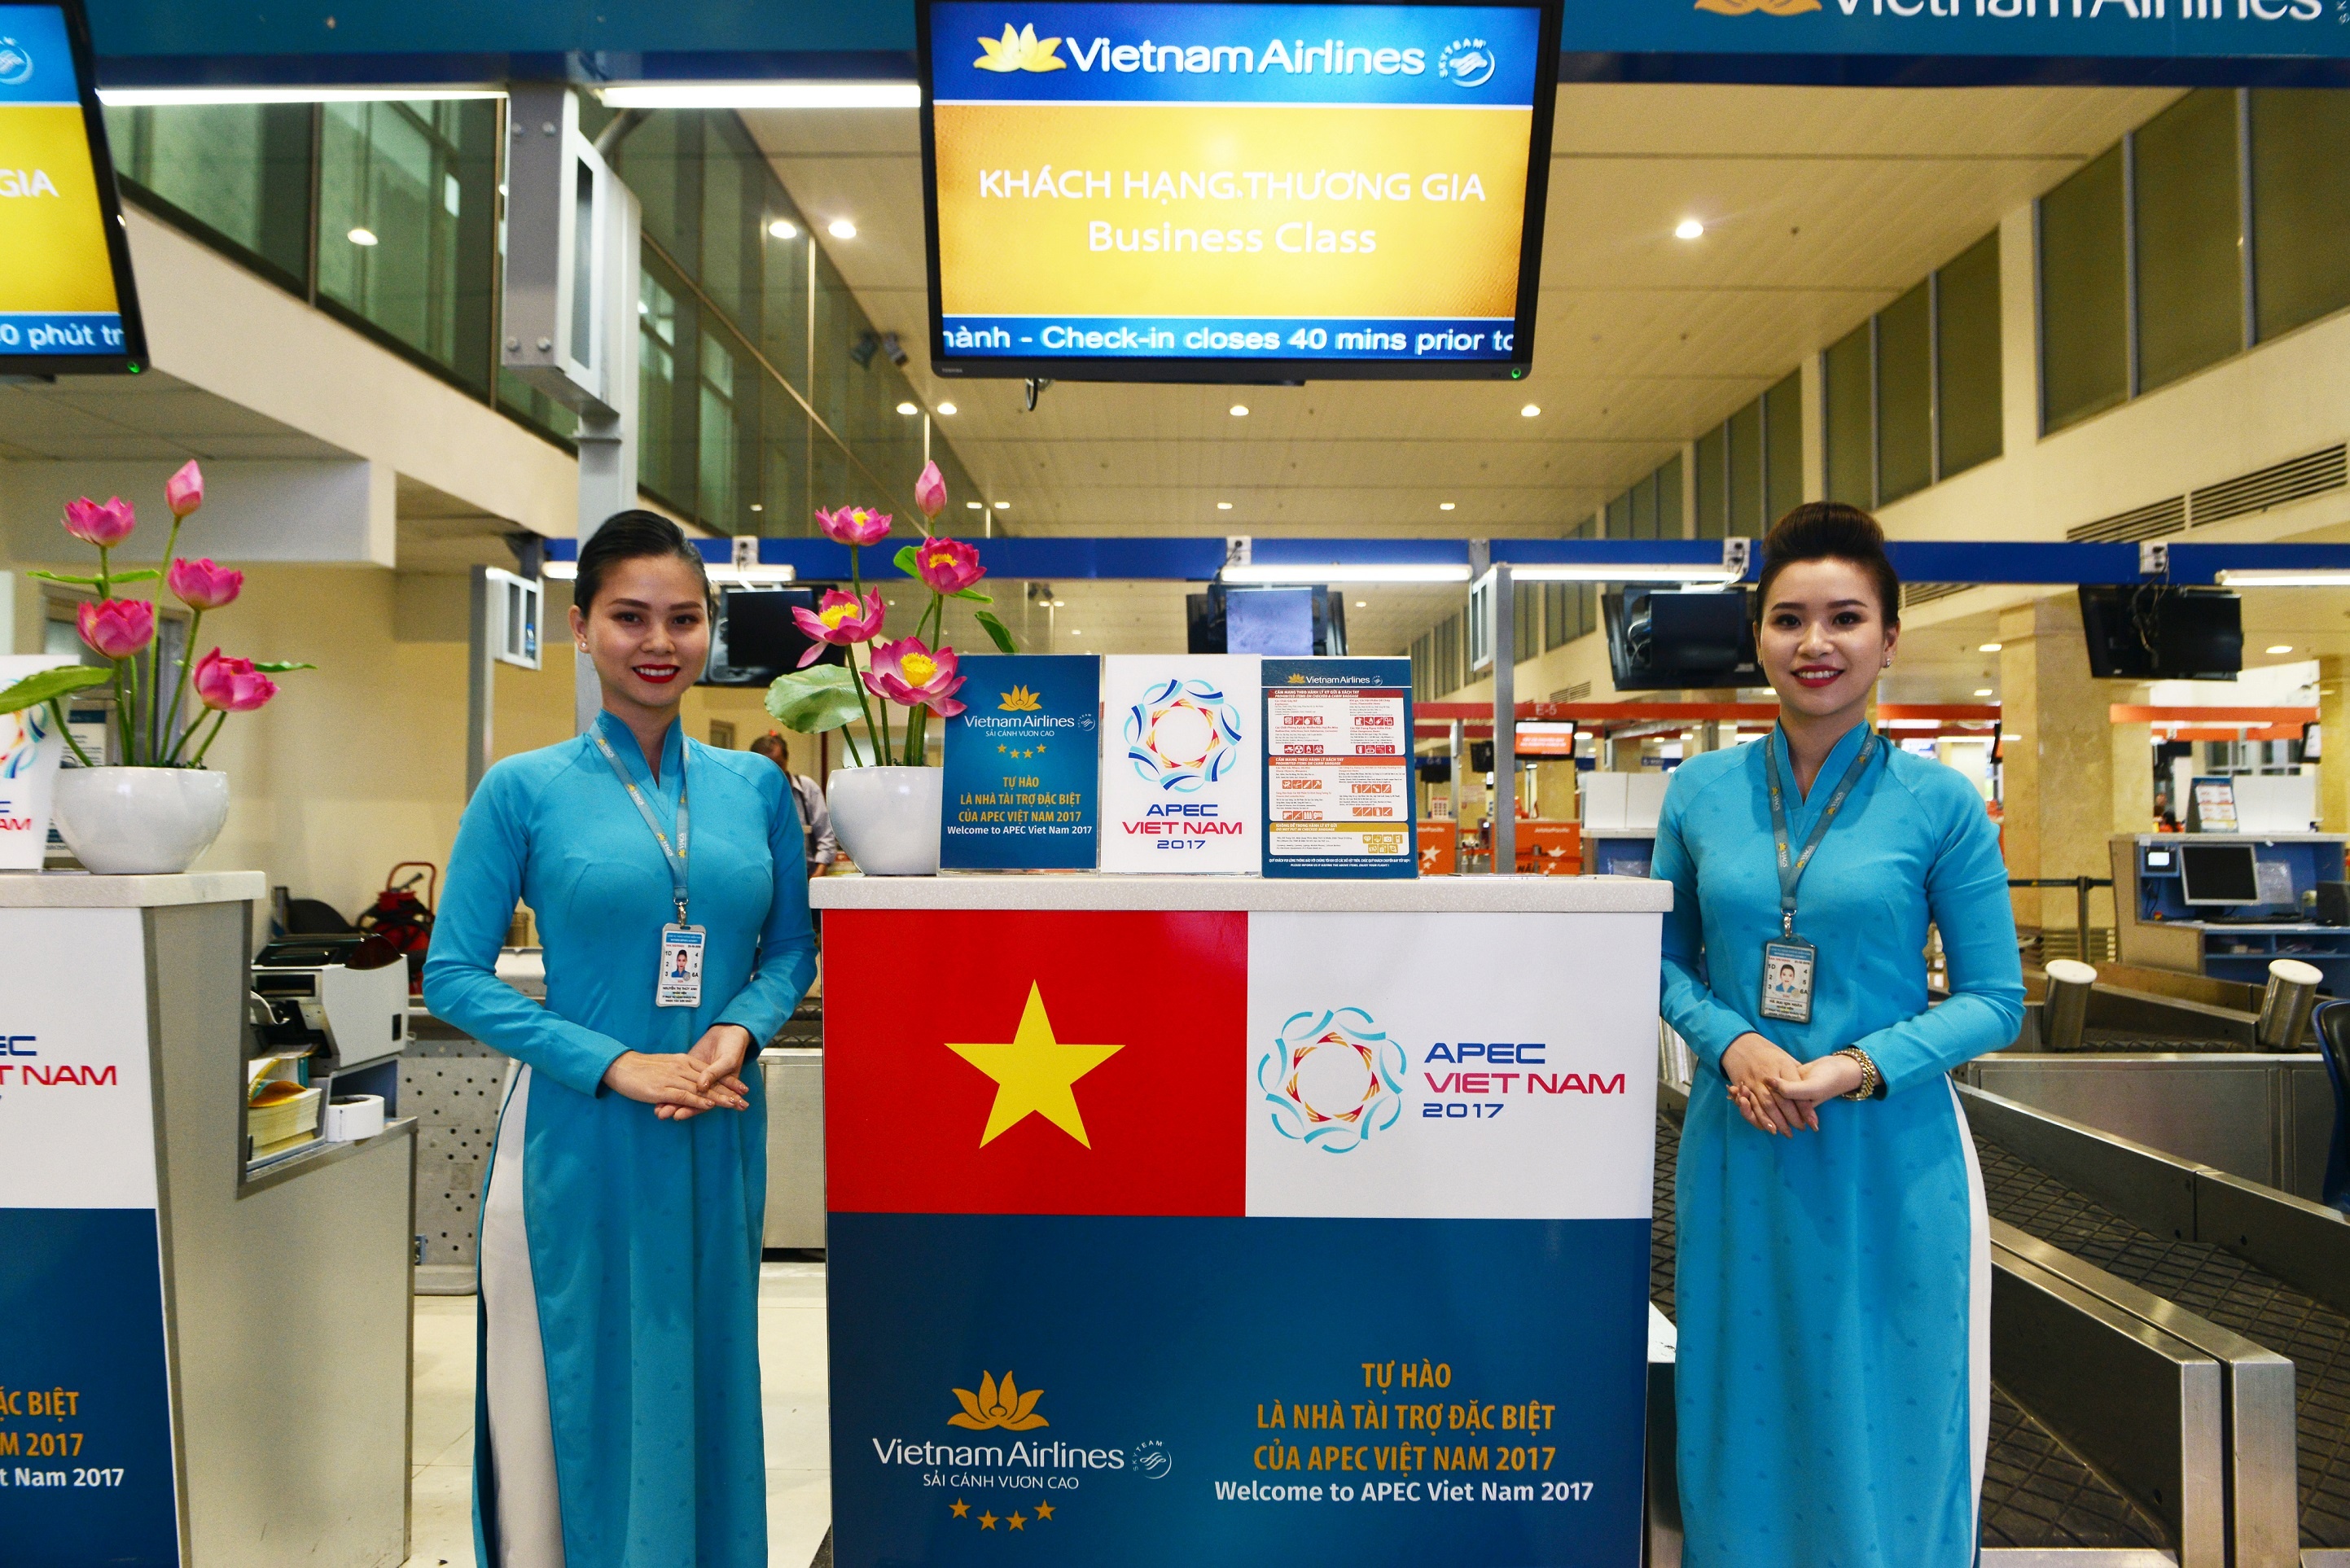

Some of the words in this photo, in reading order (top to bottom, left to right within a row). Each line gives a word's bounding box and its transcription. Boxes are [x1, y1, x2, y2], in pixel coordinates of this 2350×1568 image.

[1066, 37, 1254, 73] Vietnam
[1257, 38, 1426, 74] Airlines
[980, 165, 1111, 199] KHÁCH
[1243, 169, 1410, 201] THƯƠNG
[1421, 173, 1487, 201] GIA
[1089, 221, 1263, 253] Business
[1275, 221, 1377, 254] Class
[0, 323, 20, 345] 0
[27, 322, 97, 351] phút
[1042, 326, 1174, 350] Check-in
[1185, 327, 1280, 350] closes
[1287, 328, 1328, 350] 40
[1338, 329, 1407, 351] mins
[1416, 329, 1485, 356] prior
[1305, 676, 1341, 684] Vietnam
[1339, 676, 1370, 684] Airlines
[964, 715, 1021, 728] Vietnam
[1023, 715, 1075, 728] Airlines
[1002, 776, 1017, 791] TỰ
[1018, 775, 1040, 787] HÀO
[960, 792, 972, 804] LÀ
[975, 792, 996, 804] NHÀ
[998, 792, 1014, 804] TÀI
[1016, 793, 1037, 807] TRỢ
[1037, 791, 1057, 807] ĐẶC
[1059, 791, 1081, 807] BIỆT
[958, 808, 978, 822] CỦA
[980, 811, 1005, 821] APEC
[1007, 809, 1028, 824] VIỆT
[1031, 811, 1054, 821] NAM
[1057, 812, 1081, 821] 2017
[1146, 804, 1218, 817] APEC
[947, 826, 989, 834] Welcome
[991, 826, 1001, 834] to
[1002, 826, 1026, 834] APEC
[1028, 826, 1046, 834] Viet
[1049, 826, 1069, 834] Nam
[1072, 826, 1093, 834] 2017
[1121, 821, 1179, 834] VIET
[1183, 821, 1243, 834] NAM
[1156, 839, 1206, 849] 2017
[0, 1036, 37, 1057] C
[1423, 1042, 1546, 1064] APEC
[22, 1065, 117, 1085] NAM
[1423, 1072, 1520, 1093] VIET
[1528, 1073, 1625, 1094] NAM
[1423, 1102, 1505, 1119] 2017
[1361, 1360, 1396, 1395] TỰ
[1401, 1358, 1452, 1387] HÀO
[28, 1386, 80, 1422] BIỆT
[1257, 1399, 1286, 1429] LÀ
[1293, 1399, 1345, 1429] NHÀ
[1351, 1399, 1388, 1429] TÀI
[1395, 1403, 1444, 1437] TRỢ
[1448, 1399, 1495, 1437] ĐẶC
[1502, 1399, 1556, 1437] BIỆT
[26, 1432, 84, 1457] 2017
[872, 1438, 1002, 1466] Vietnam
[1006, 1440, 1125, 1469] Airlines
[1132, 1439, 1163, 1472] SKYTEAM
[1253, 1438, 1299, 1471] CỦA
[1307, 1446, 1368, 1471] APEC
[1374, 1441, 1427, 1478] VIỆT
[1434, 1446, 1488, 1471] NAM
[1496, 1447, 1556, 1471] 2017
[15, 1467, 67, 1487] Nam
[72, 1468, 125, 1487] 2017
[923, 1469, 945, 1487] SẢI
[951, 1470, 994, 1487] CÁNH
[1000, 1474, 1044, 1488] VƯƠN
[1047, 1476, 1079, 1490] CAO
[1214, 1479, 1323, 1501] Welcome
[1330, 1482, 1354, 1501] to
[1361, 1482, 1422, 1502] APEC
[1427, 1480, 1475, 1501] Viet
[1481, 1482, 1534, 1501] Nam
[1541, 1482, 1594, 1501] 2017
